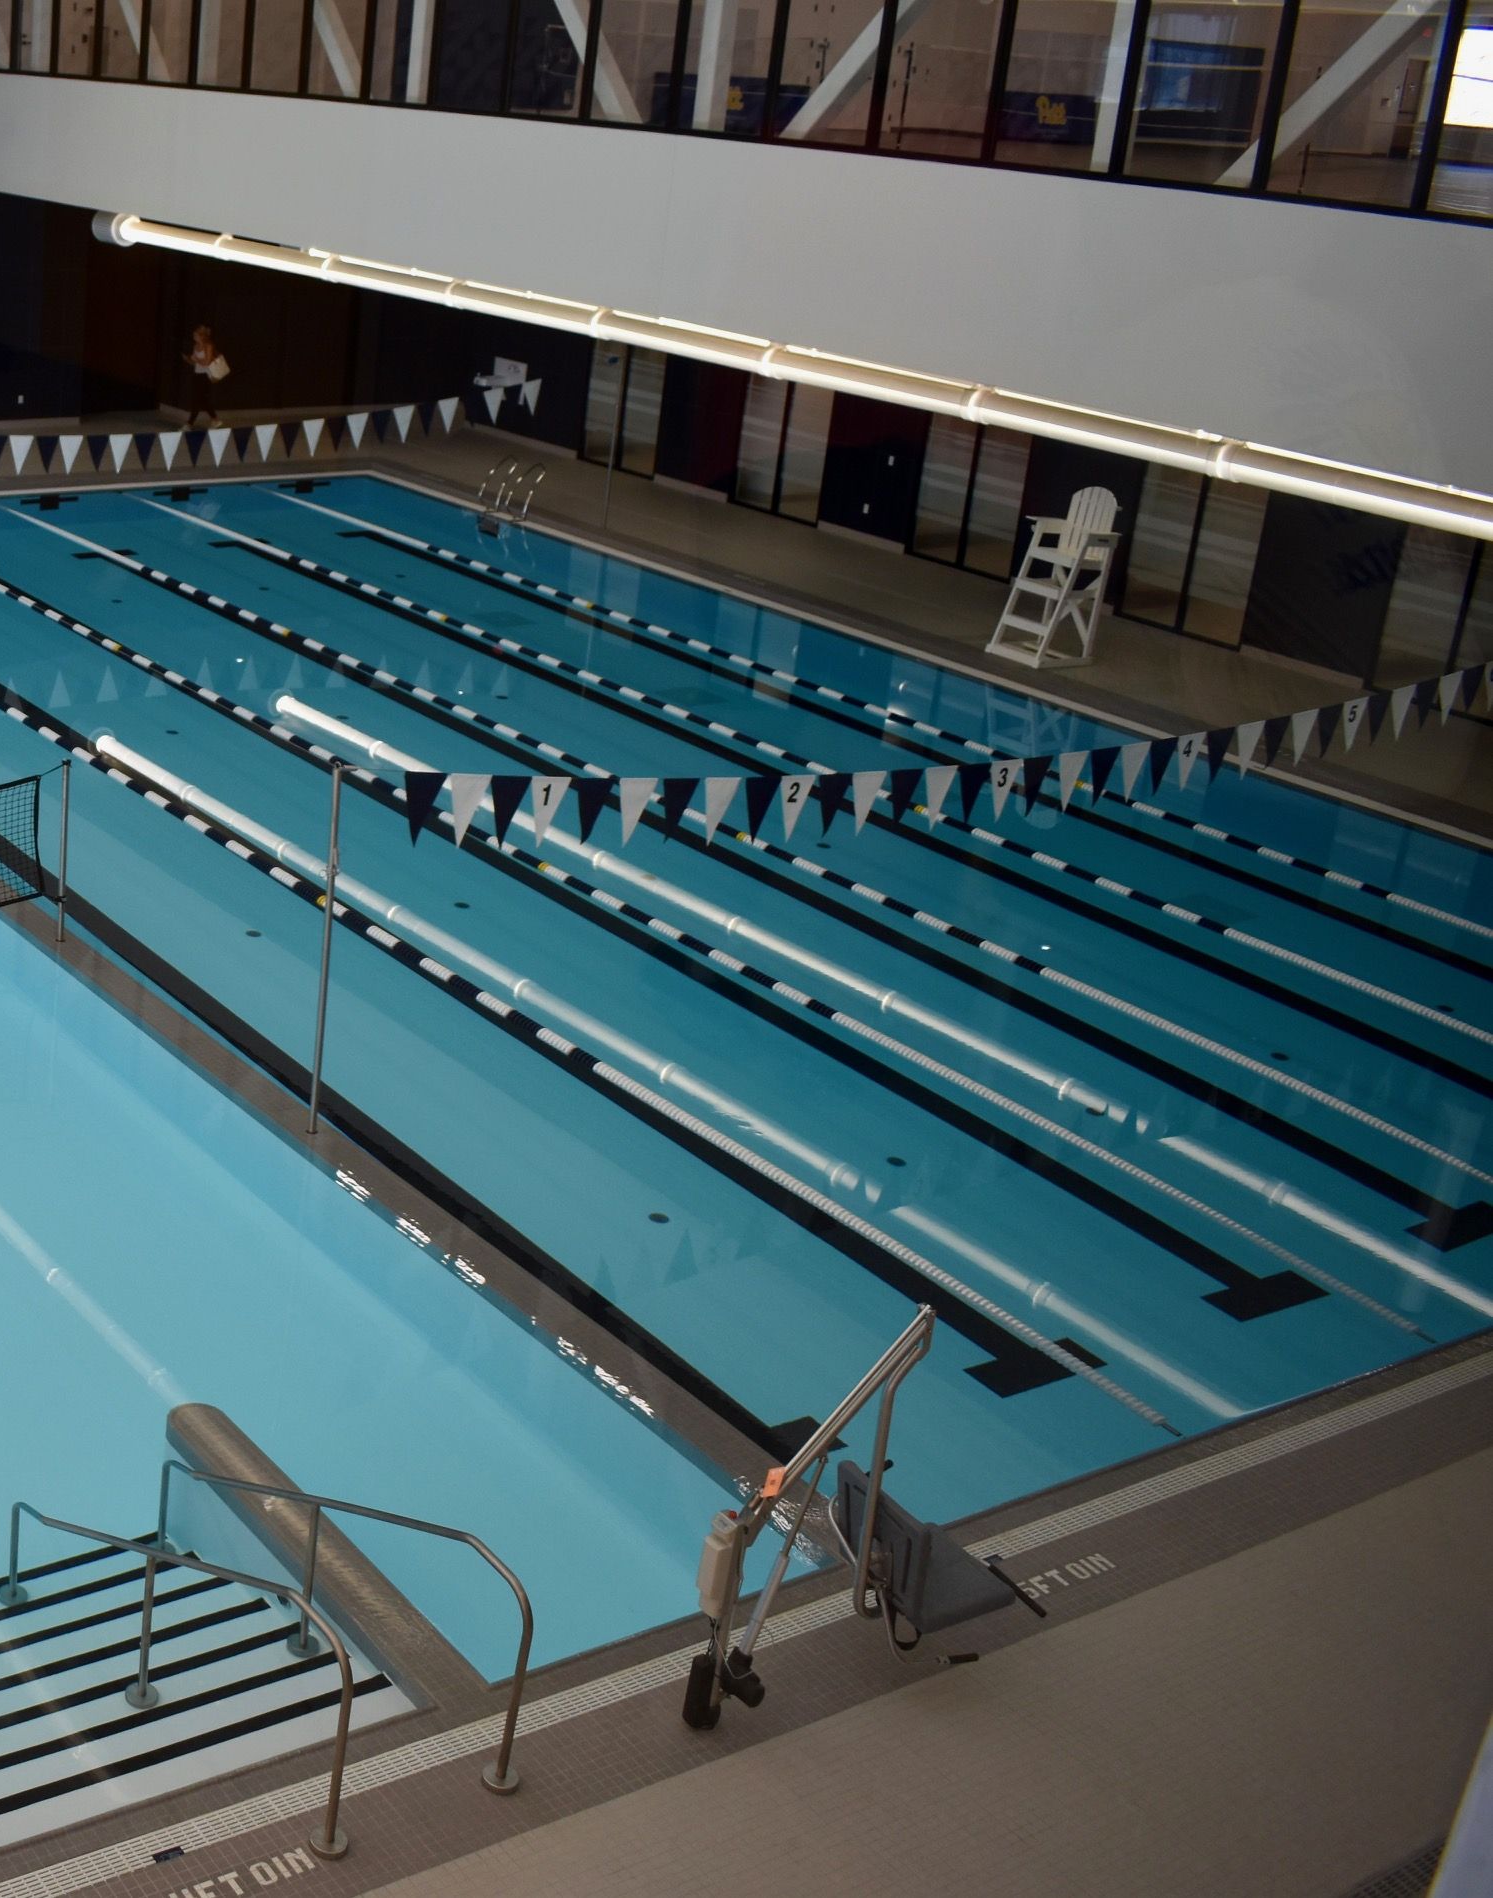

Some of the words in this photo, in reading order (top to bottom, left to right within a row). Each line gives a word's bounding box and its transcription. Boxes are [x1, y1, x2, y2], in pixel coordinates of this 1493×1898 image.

[1348, 704, 1359, 723] 5
[1182, 739, 1194, 758] 4
[997, 767, 1009, 788] 3
[542, 783, 552, 806] 1
[787, 782, 801, 803] 2
